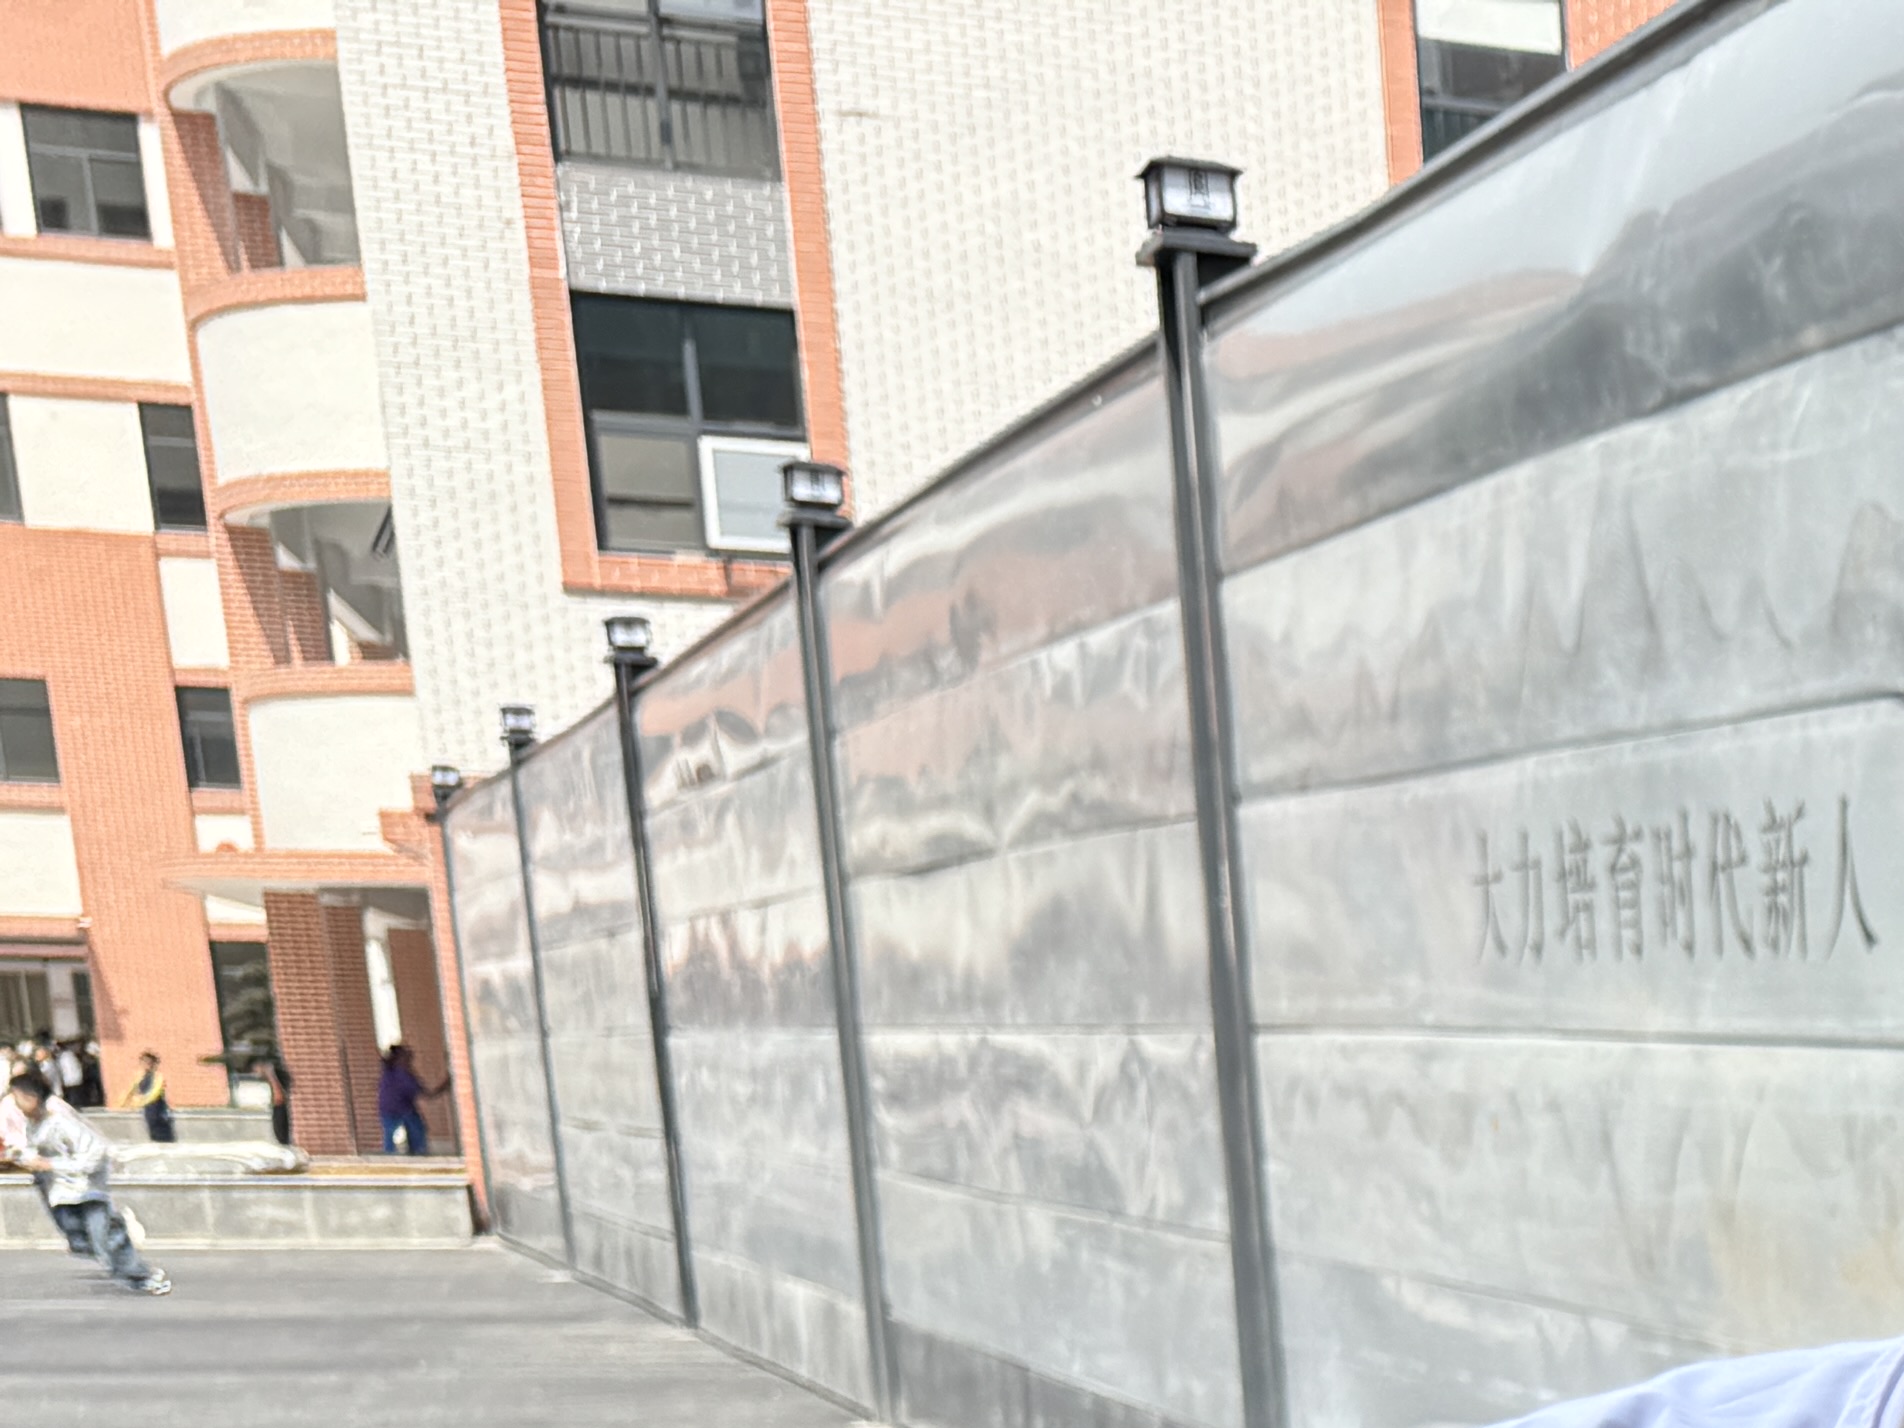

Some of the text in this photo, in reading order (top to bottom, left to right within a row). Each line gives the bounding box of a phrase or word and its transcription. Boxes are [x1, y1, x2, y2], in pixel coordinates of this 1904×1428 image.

[1474, 794, 1878, 963] 大力培育时代新人
